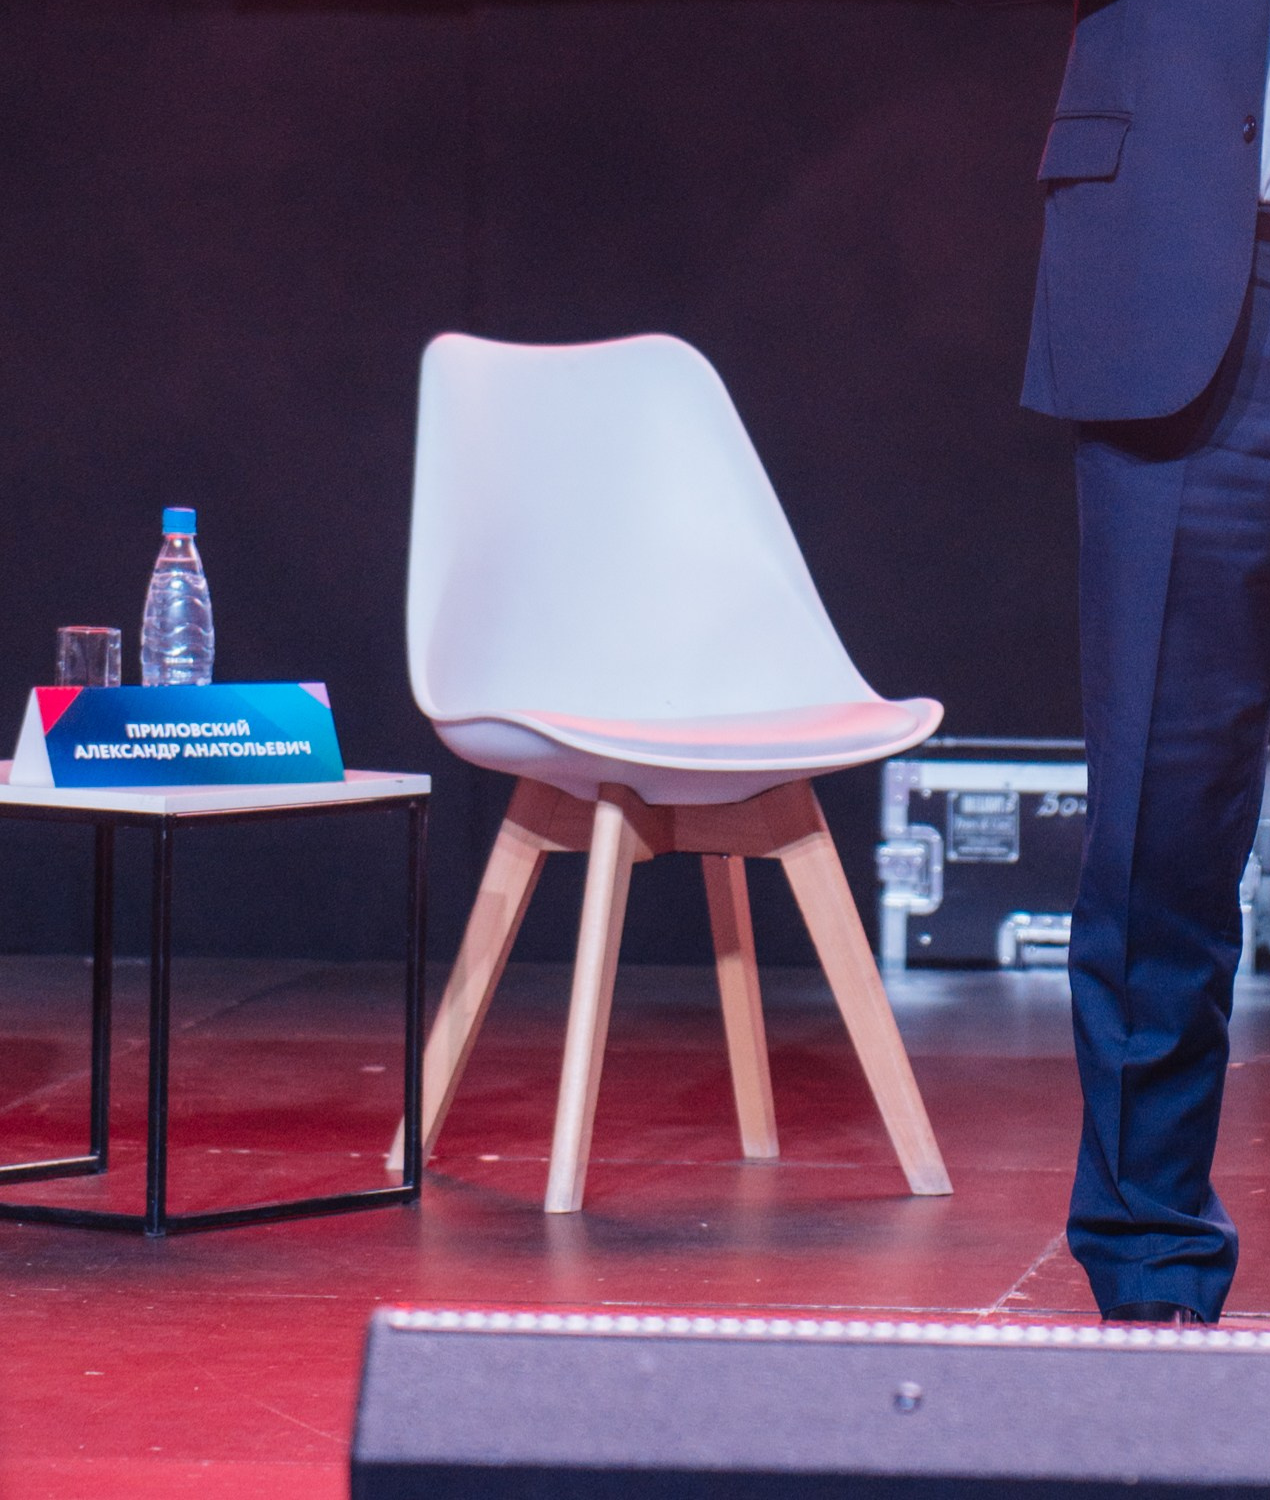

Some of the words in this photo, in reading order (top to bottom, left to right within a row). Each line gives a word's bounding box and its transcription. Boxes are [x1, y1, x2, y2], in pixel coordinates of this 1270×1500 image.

[126, 719, 251, 738] ПРИЛОВСКИЙ
[74, 743, 181, 760] АЛЕКСАНДР
[183, 740, 312, 757] АНАТОЛЬЕВИЧ
